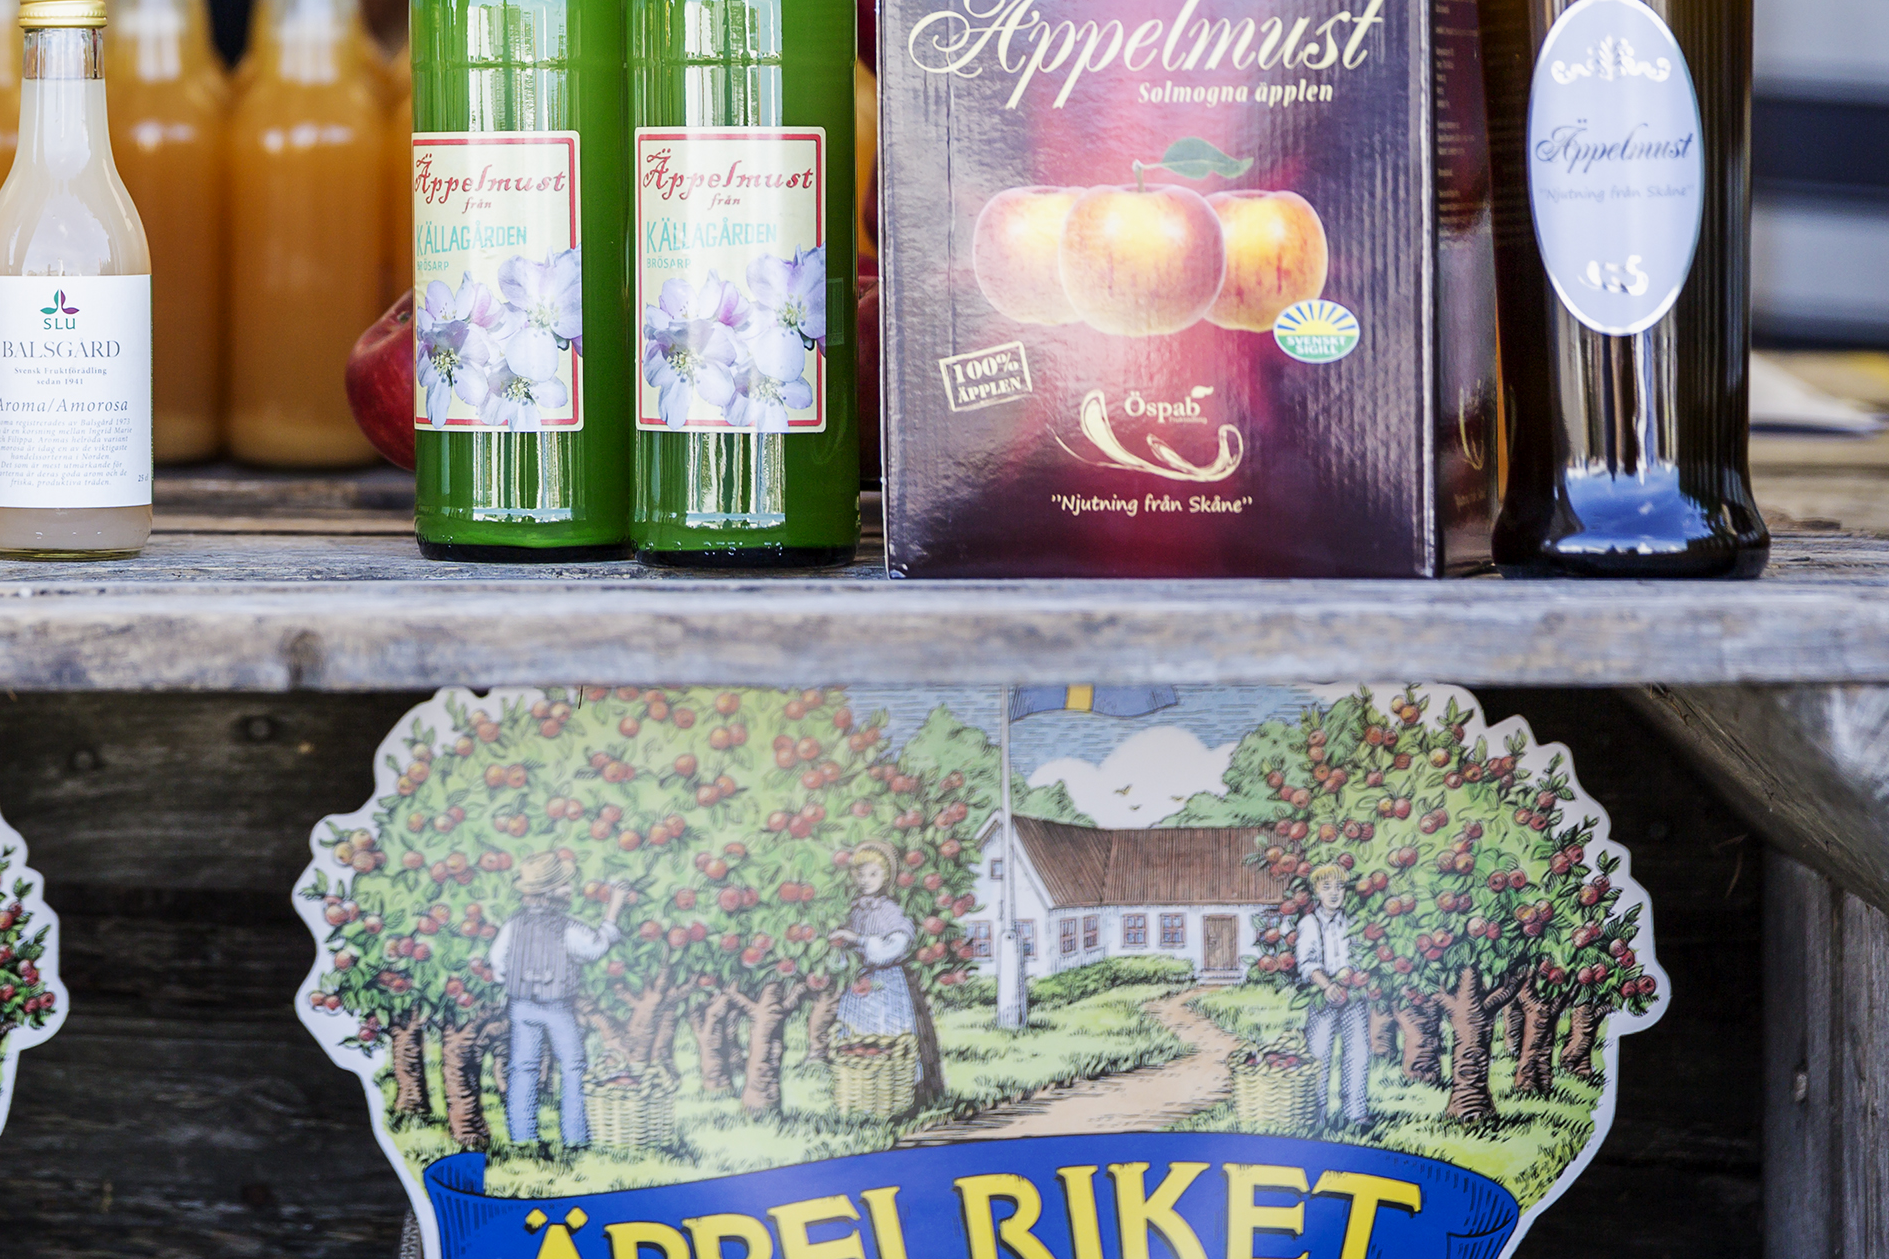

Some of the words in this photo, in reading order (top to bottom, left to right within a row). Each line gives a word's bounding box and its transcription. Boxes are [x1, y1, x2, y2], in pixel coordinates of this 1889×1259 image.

[1138, 80, 1248, 109] Solmogna
[1254, 78, 1333, 108] äpplen
[1535, 118, 1694, 174] Äppelmust
[414, 153, 566, 204] Äppelmust
[642, 148, 814, 200] Äppelmust
[462, 197, 492, 214] från
[707, 193, 741, 211] från
[416, 220, 527, 257] KÄLLAGÅRDEN
[646, 217, 777, 254] KÄLLAGÅRDEN
[416, 258, 449, 271] BRÖSARP
[646, 255, 692, 270] BRÖSARP
[2, 337, 121, 359] BALSGÅRD
[1295, 344, 1339, 356] SIGILL
[44, 366, 108, 377] Fruktförädling
[953, 351, 1020, 384] 100%
[957, 376, 1022, 404] ÄPPLEN
[1124, 390, 1201, 424] Öspab
[16, 419, 66, 429] registrerades
[81, 418, 114, 428] Balsgård
[116, 417, 131, 426] 1973
[22, 427, 56, 437] korsning
[89, 427, 112, 436] Ingrid
[104, 435, 128, 443] variant
[11, 452, 73, 460] handelssorterna
[38, 444, 56, 454] idag
[94, 443, 127, 453] viktigaste
[1, 460, 12, 468] Det
[64, 461, 110, 469] utmärkande
[112, 460, 122, 470] för
[61, 470, 81, 480] goda
[105, 469, 118, 477] och
[120, 468, 128, 476] de
[37, 478, 81, 488] produktiva
[1144, 492, 1183, 513] från
